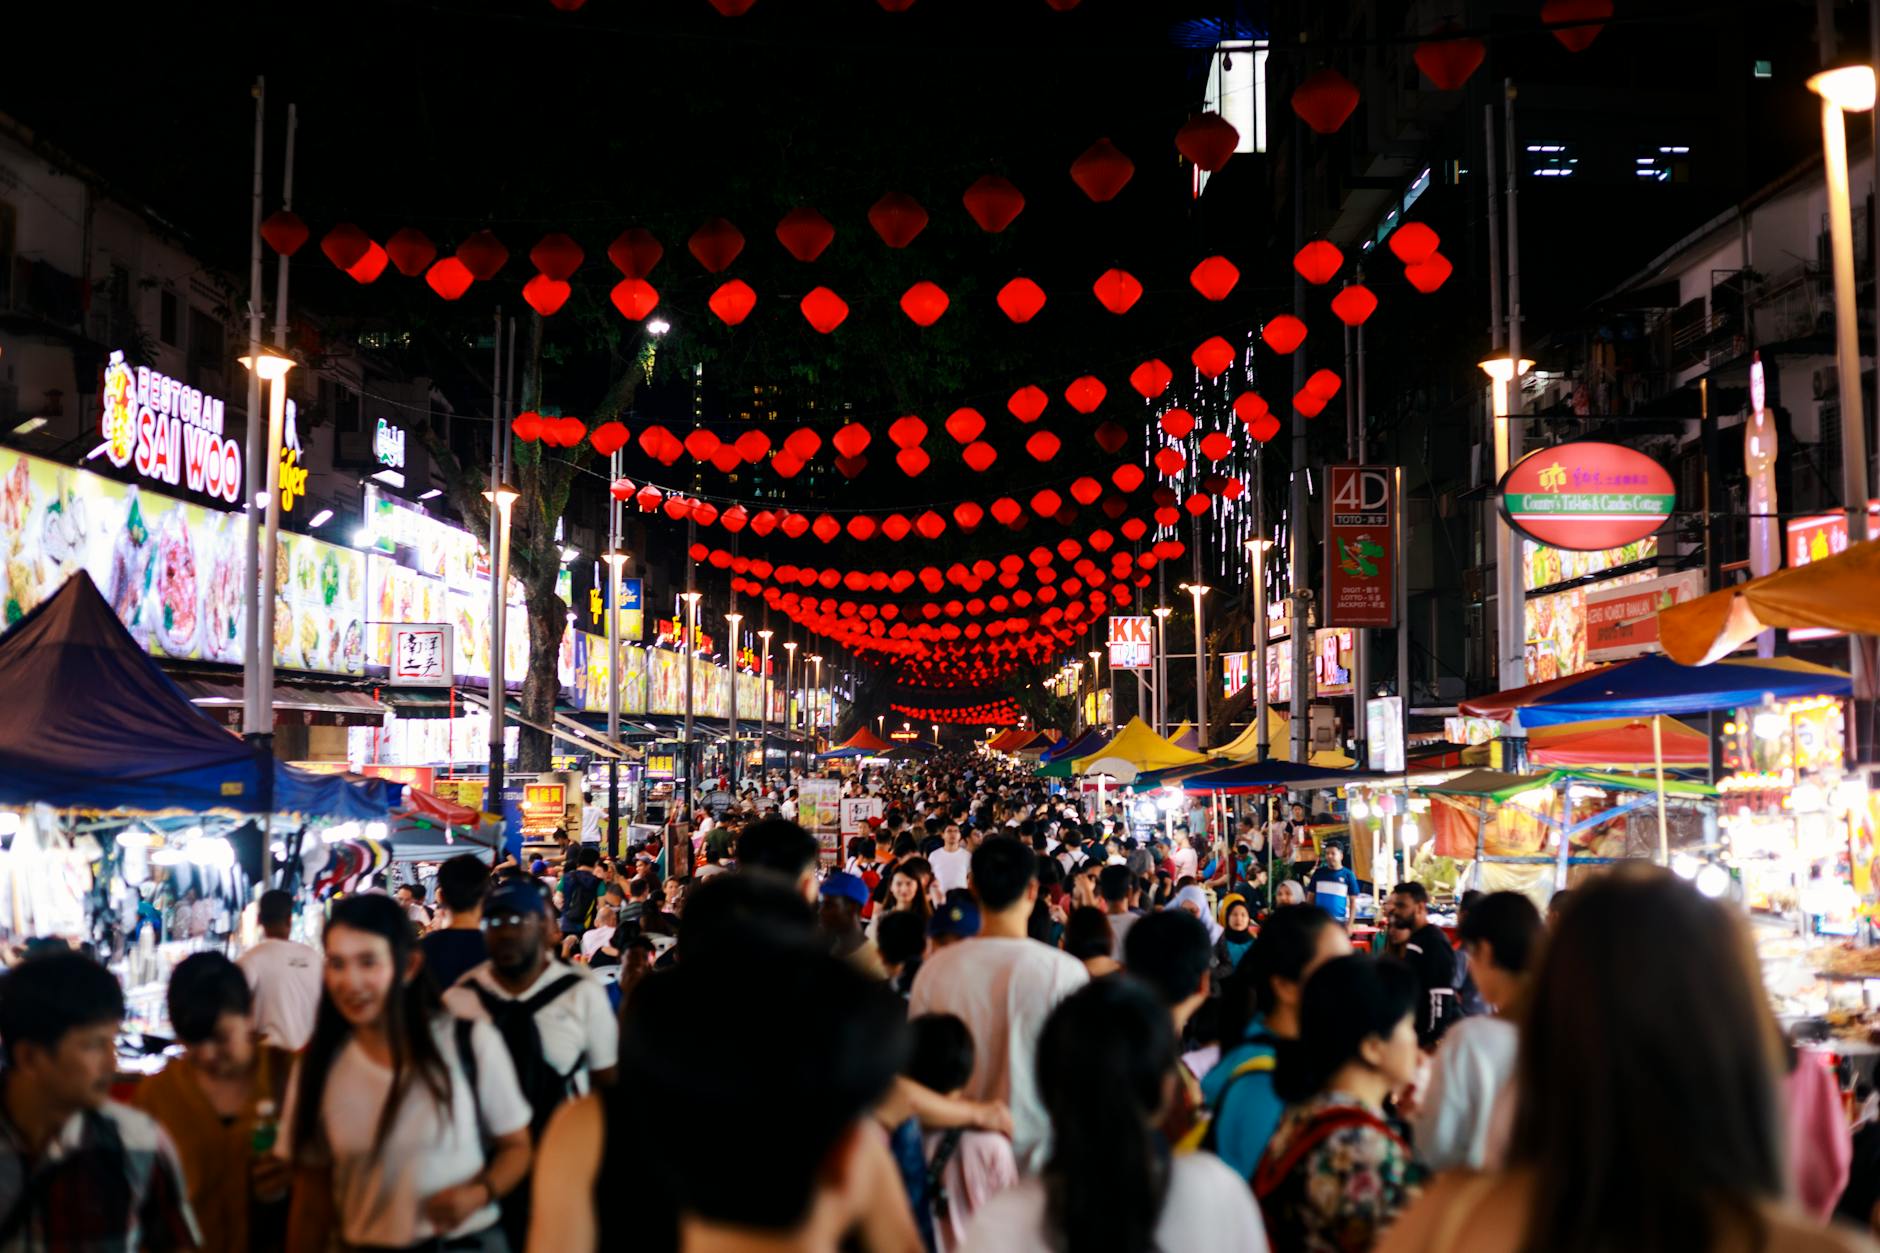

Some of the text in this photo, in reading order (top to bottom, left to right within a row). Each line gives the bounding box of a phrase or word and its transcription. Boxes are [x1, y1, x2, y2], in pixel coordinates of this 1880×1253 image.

[137, 366, 224, 435] RESTORAN
[135, 406, 181, 485] SAI
[183, 423, 241, 503] WOO
[279, 446, 308, 511] iger
[1333, 471, 1389, 510] 4D
[1337, 516, 1362, 524] TOTO
[1113, 617, 1148, 642] KK
